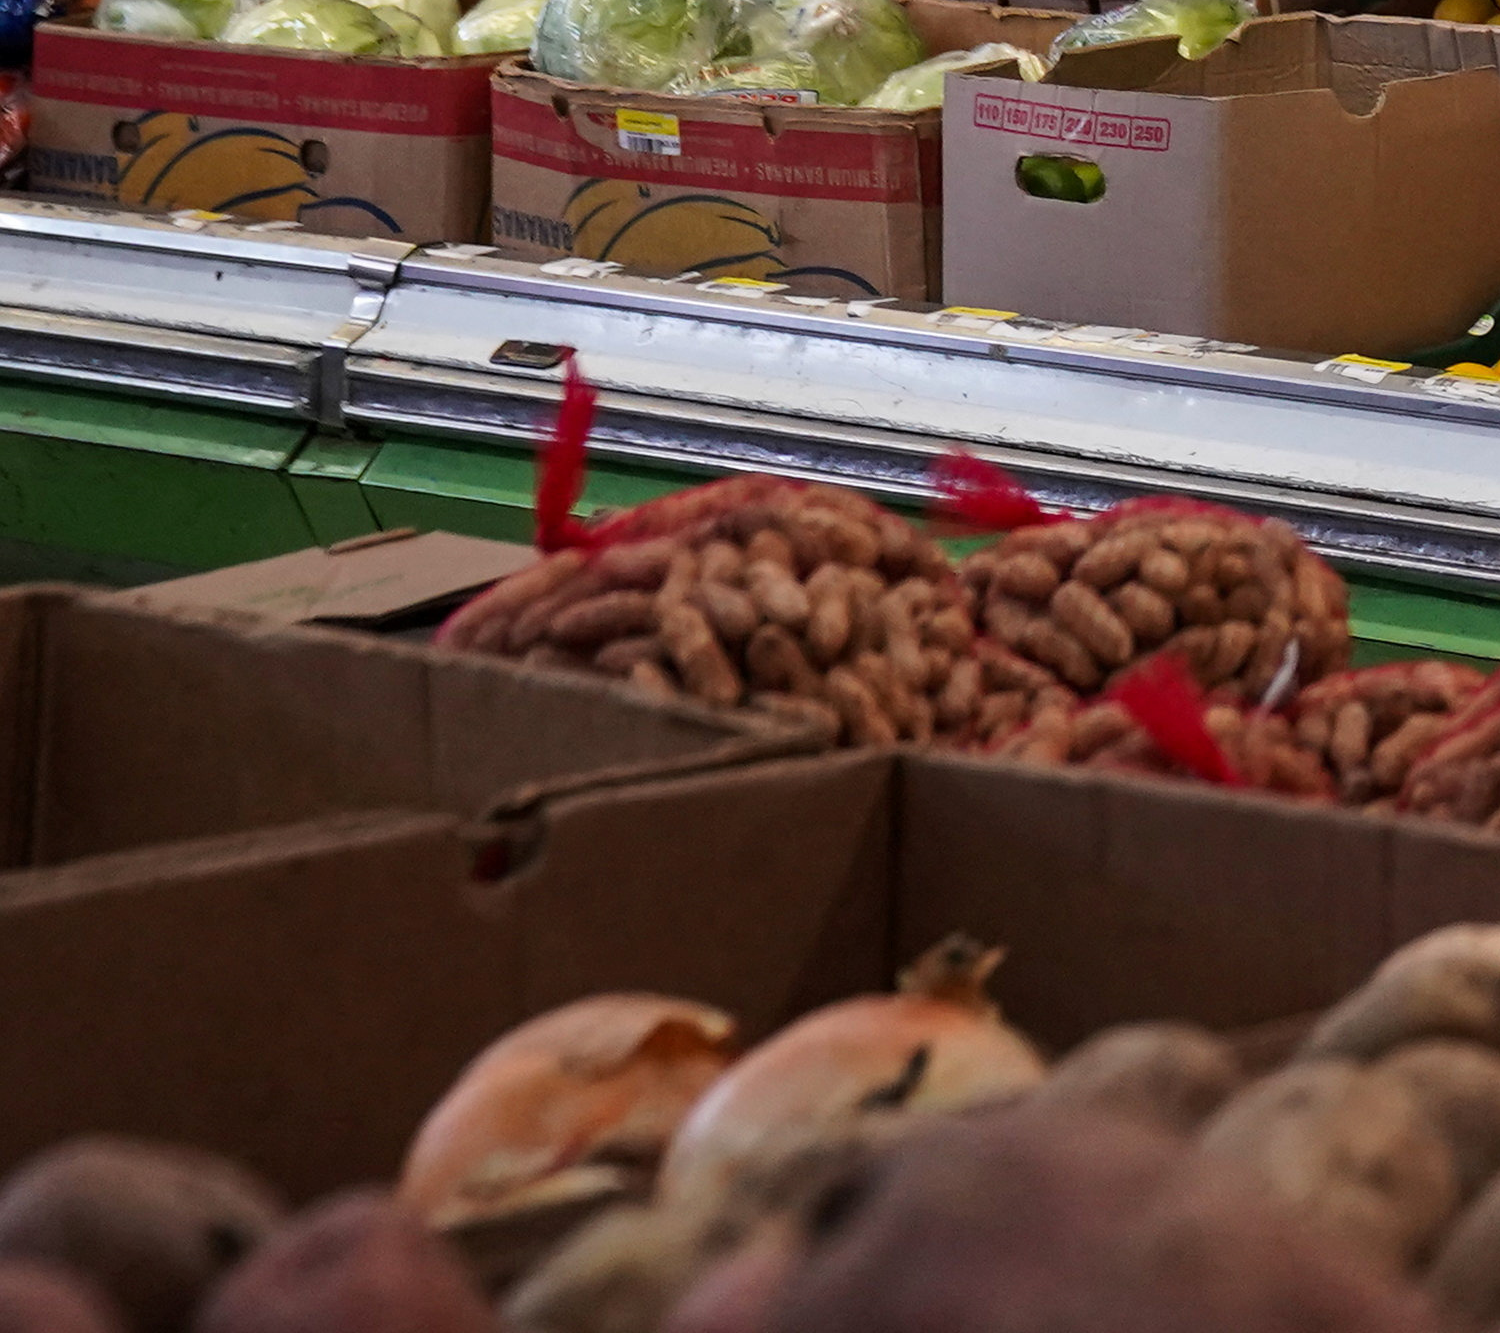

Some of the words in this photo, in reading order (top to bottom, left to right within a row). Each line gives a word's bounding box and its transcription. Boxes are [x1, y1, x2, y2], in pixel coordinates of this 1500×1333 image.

[978, 104, 1001, 121] 110
[1005, 108, 1029, 128] 150
[1033, 112, 1058, 132] 175
[1098, 122, 1127, 141] 230
[1134, 124, 1164, 145] 250
